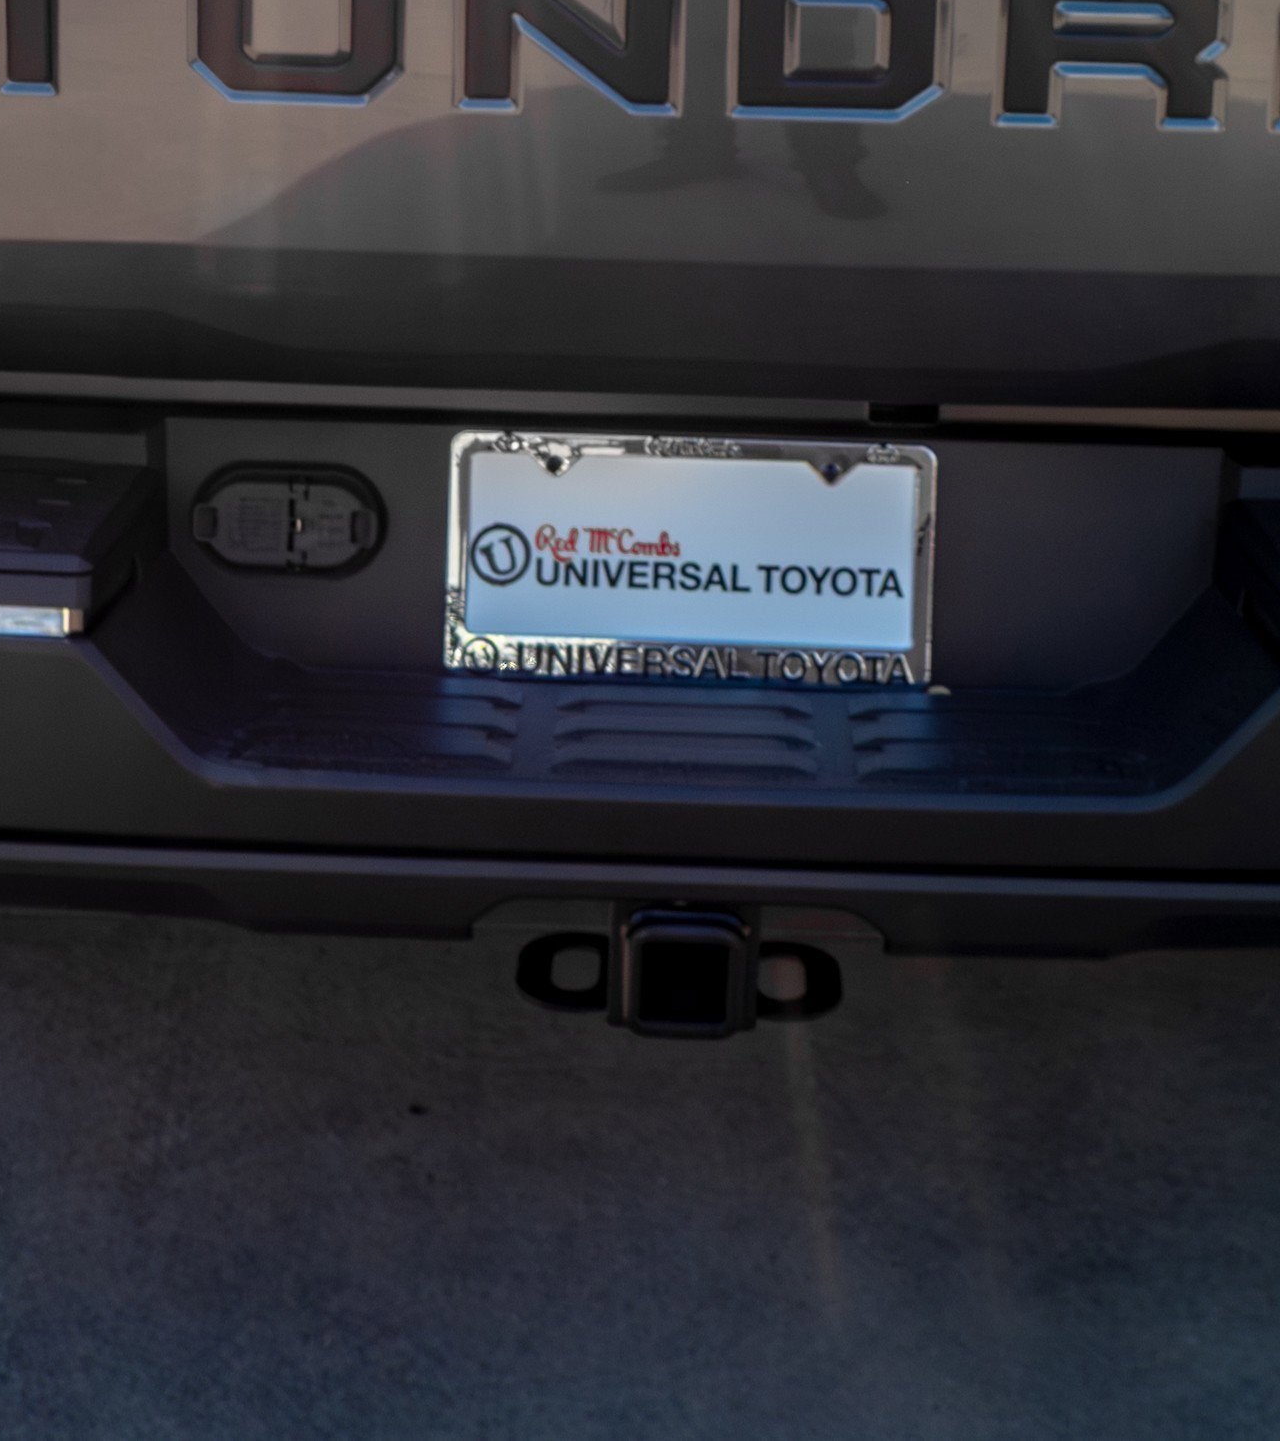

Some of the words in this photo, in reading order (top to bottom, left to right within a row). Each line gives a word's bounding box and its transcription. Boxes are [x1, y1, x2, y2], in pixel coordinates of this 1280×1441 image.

[534, 523, 580, 563] Red
[535, 557, 751, 593] UNIVERSAL
[757, 564, 904, 599] TOYOTA
[518, 640, 751, 679] UNIVERSAL
[753, 649, 915, 686] TOYOTA
